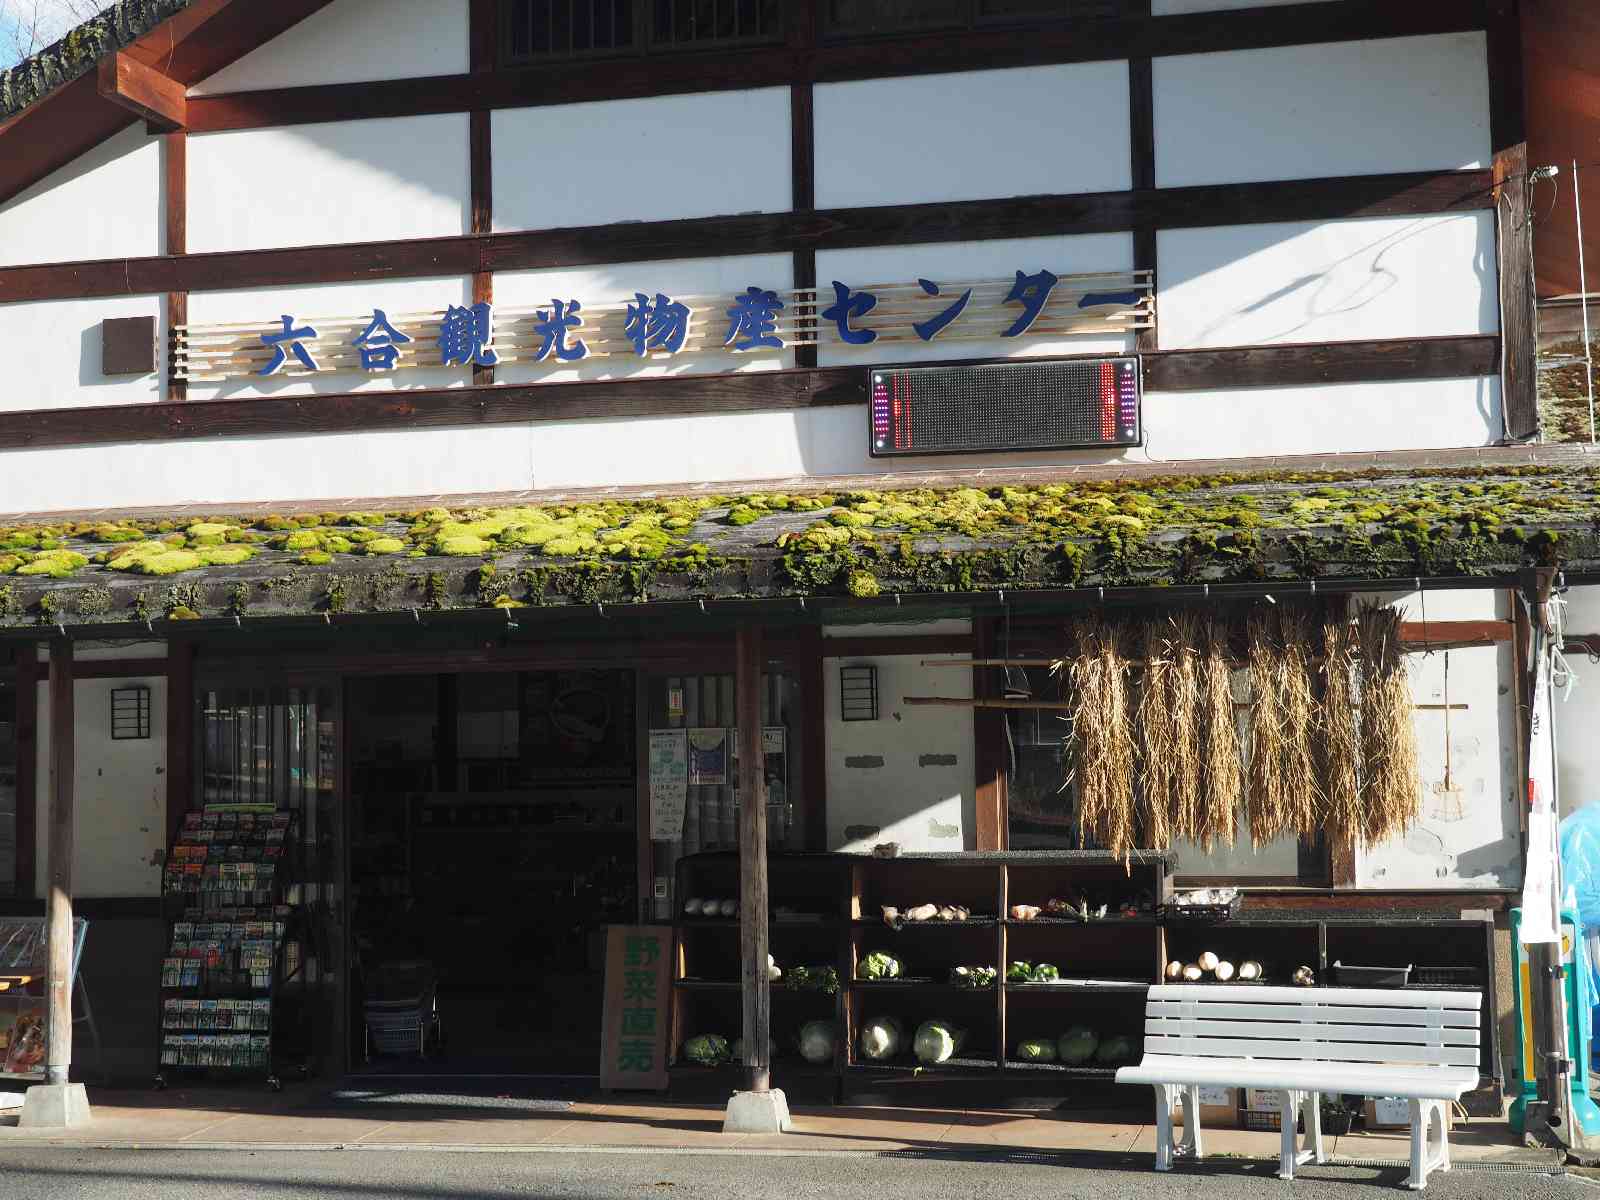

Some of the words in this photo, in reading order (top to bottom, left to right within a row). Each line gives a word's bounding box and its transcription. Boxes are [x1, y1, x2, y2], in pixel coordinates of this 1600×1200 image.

[259, 268, 1139, 375] 六合観光物産センター
[617, 937, 661, 1072] 野菜直売
